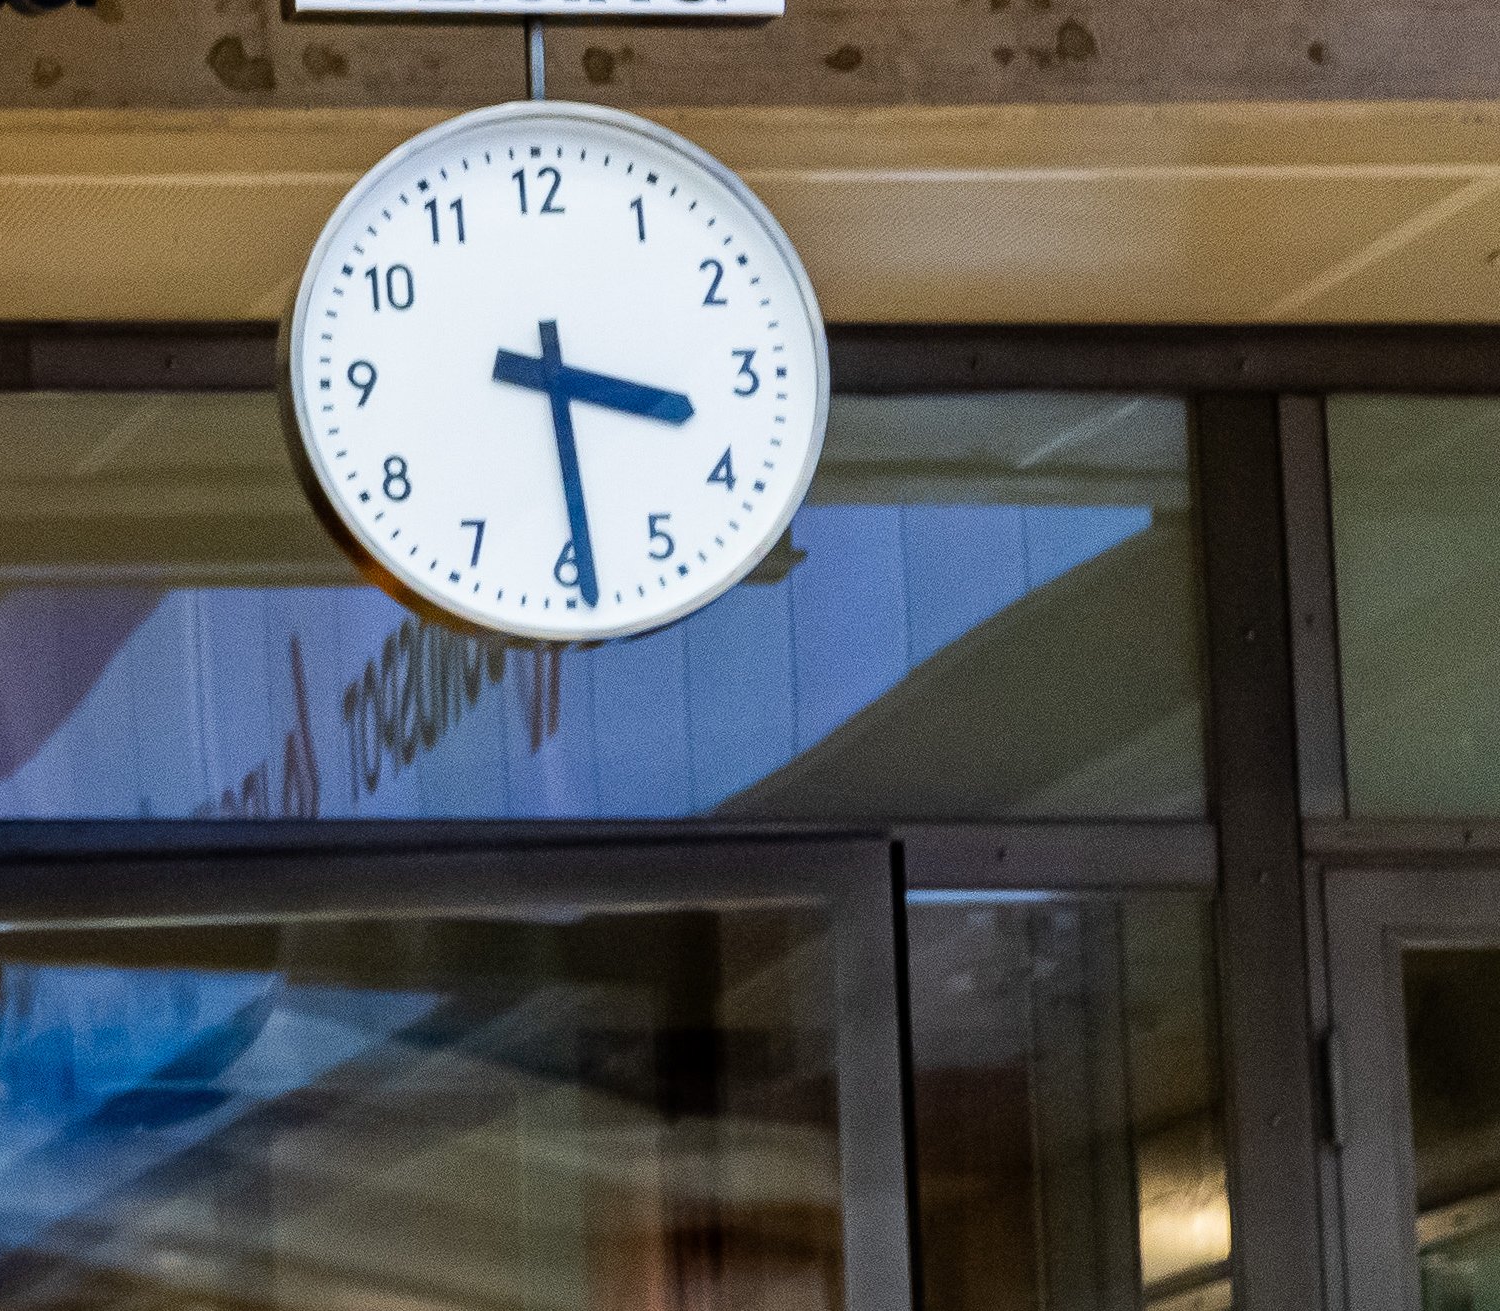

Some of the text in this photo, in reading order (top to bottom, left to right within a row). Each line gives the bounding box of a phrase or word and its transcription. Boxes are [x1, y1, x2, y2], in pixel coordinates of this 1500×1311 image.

[512, 166, 565, 214] 12
[424, 198, 465, 243] 11
[630, 197, 646, 241] 1
[365, 264, 414, 311] 10
[700, 259, 727, 305] 2
[347, 360, 377, 407] 9
[732, 350, 760, 397] 3
[382, 456, 412, 502] 8
[707, 448, 736, 490] 4
[461, 520, 486, 566] 7
[648, 514, 675, 560] 5
[553, 539, 584, 587] 6
